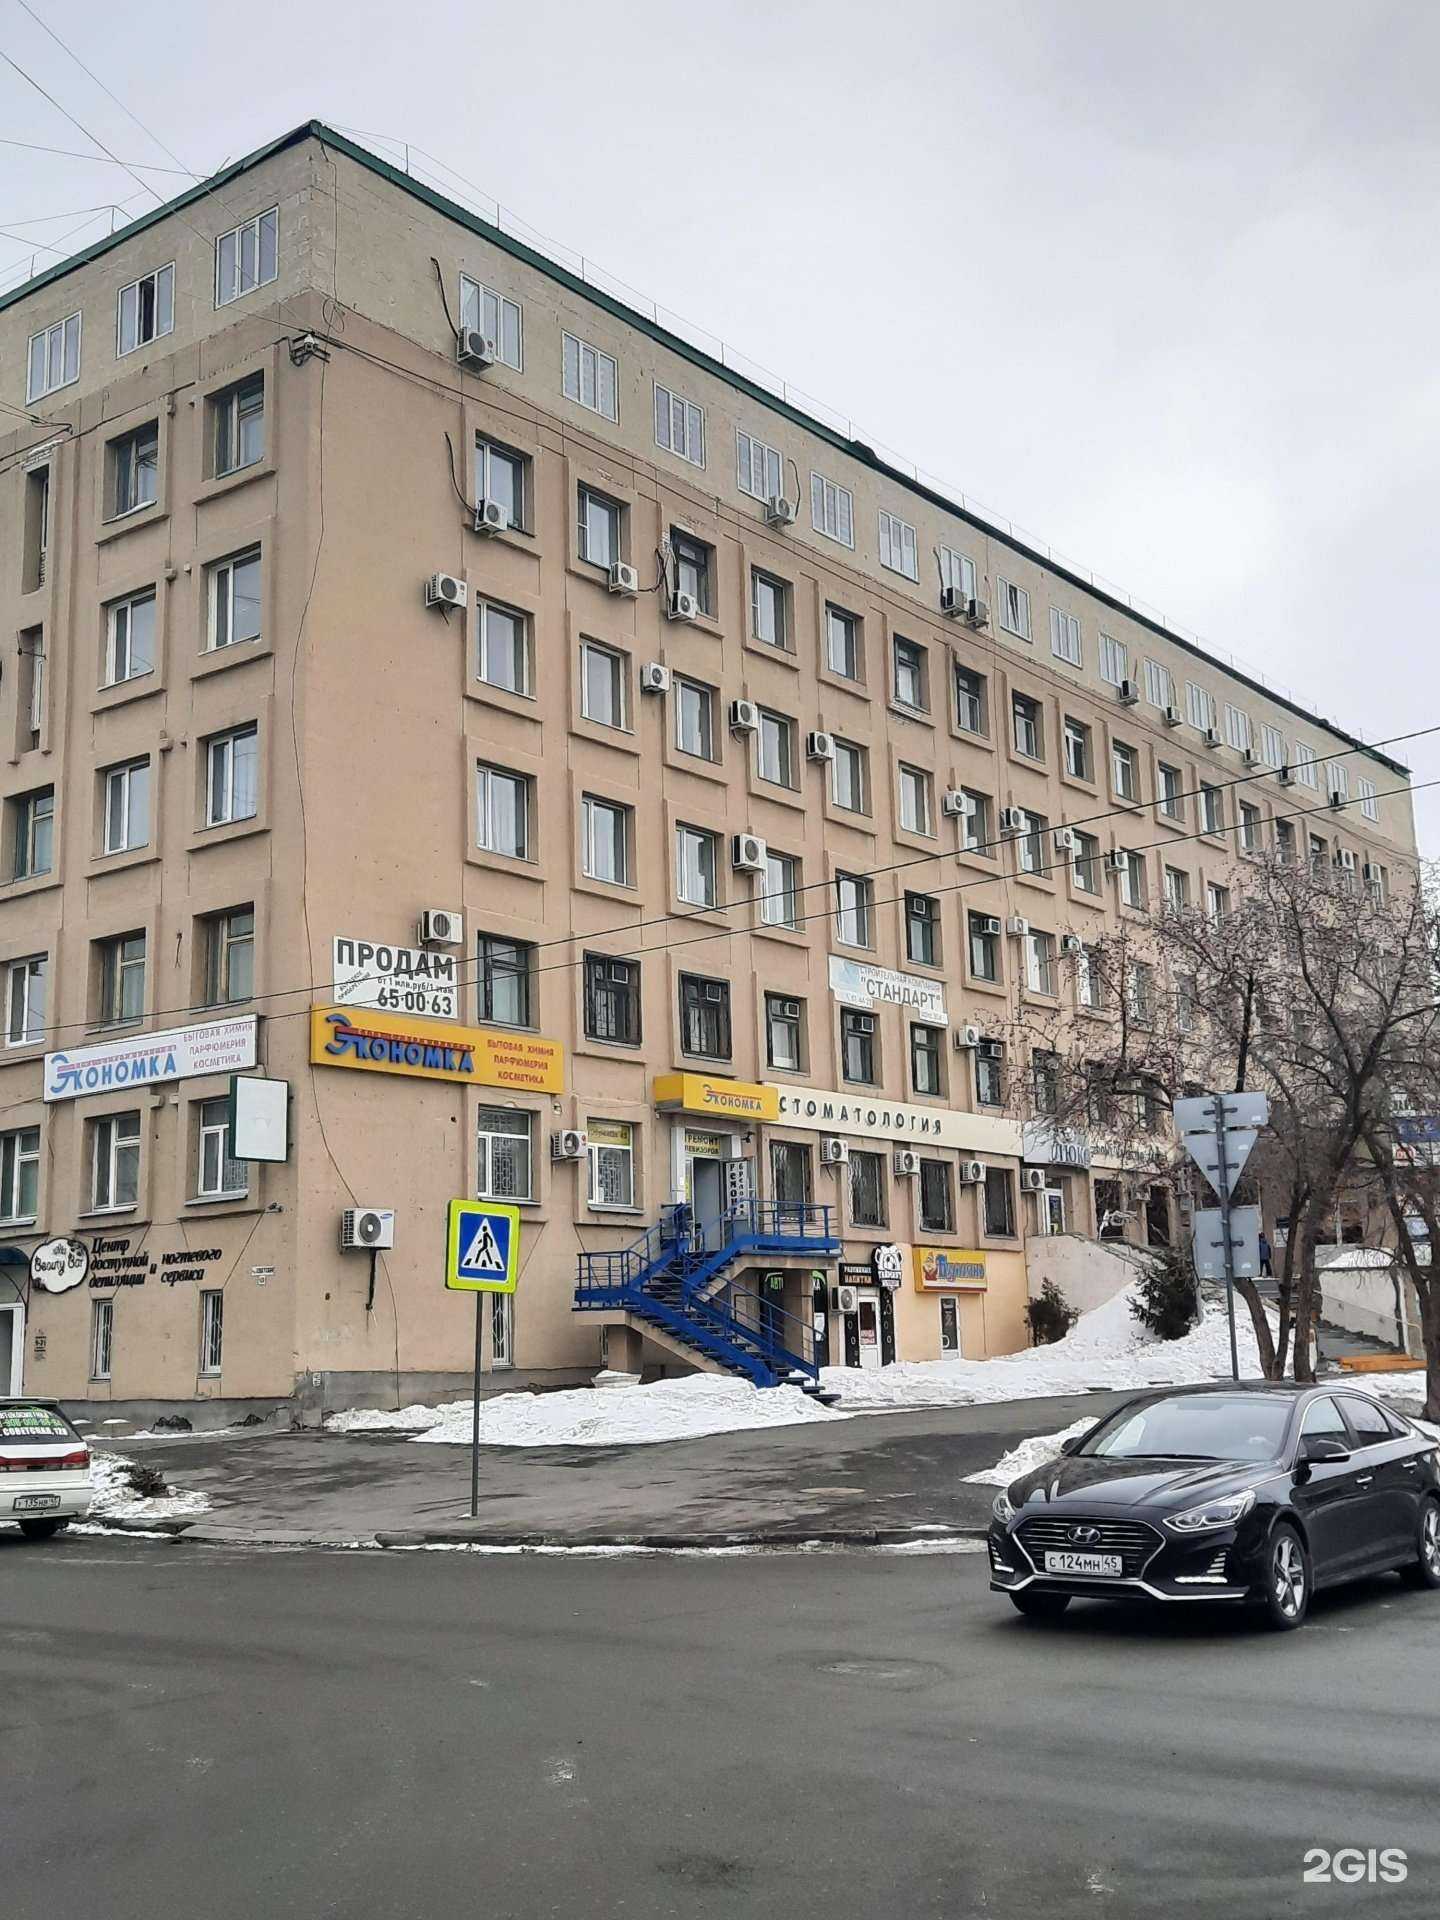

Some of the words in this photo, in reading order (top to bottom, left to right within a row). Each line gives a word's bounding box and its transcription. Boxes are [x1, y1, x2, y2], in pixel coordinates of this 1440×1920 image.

[337, 939, 453, 981] ПРОДАМ
[189, 1037, 247, 1056] ПАРФЮМЕРИЯ
[487, 1038, 524, 1052] БЫТОВАЯ
[527, 1045, 555, 1057] ХИМИЯ
[193, 1053, 242, 1070] КОСМЕТИКА
[493, 1053, 549, 1071] ПАРФЮМЕРИЯ
[497, 1070, 545, 1084] КОСМЕТИКА
[779, 1096, 943, 1136] СТОМАТОЛОГИЯ
[687, 1134, 719, 1146] РЕМОНТ
[91, 1237, 130, 1257] Центр
[90, 1251, 149, 1273] доступной
[161, 1248, 222, 1266] ногтевого
[160, 1267, 205, 1288] сервиса
